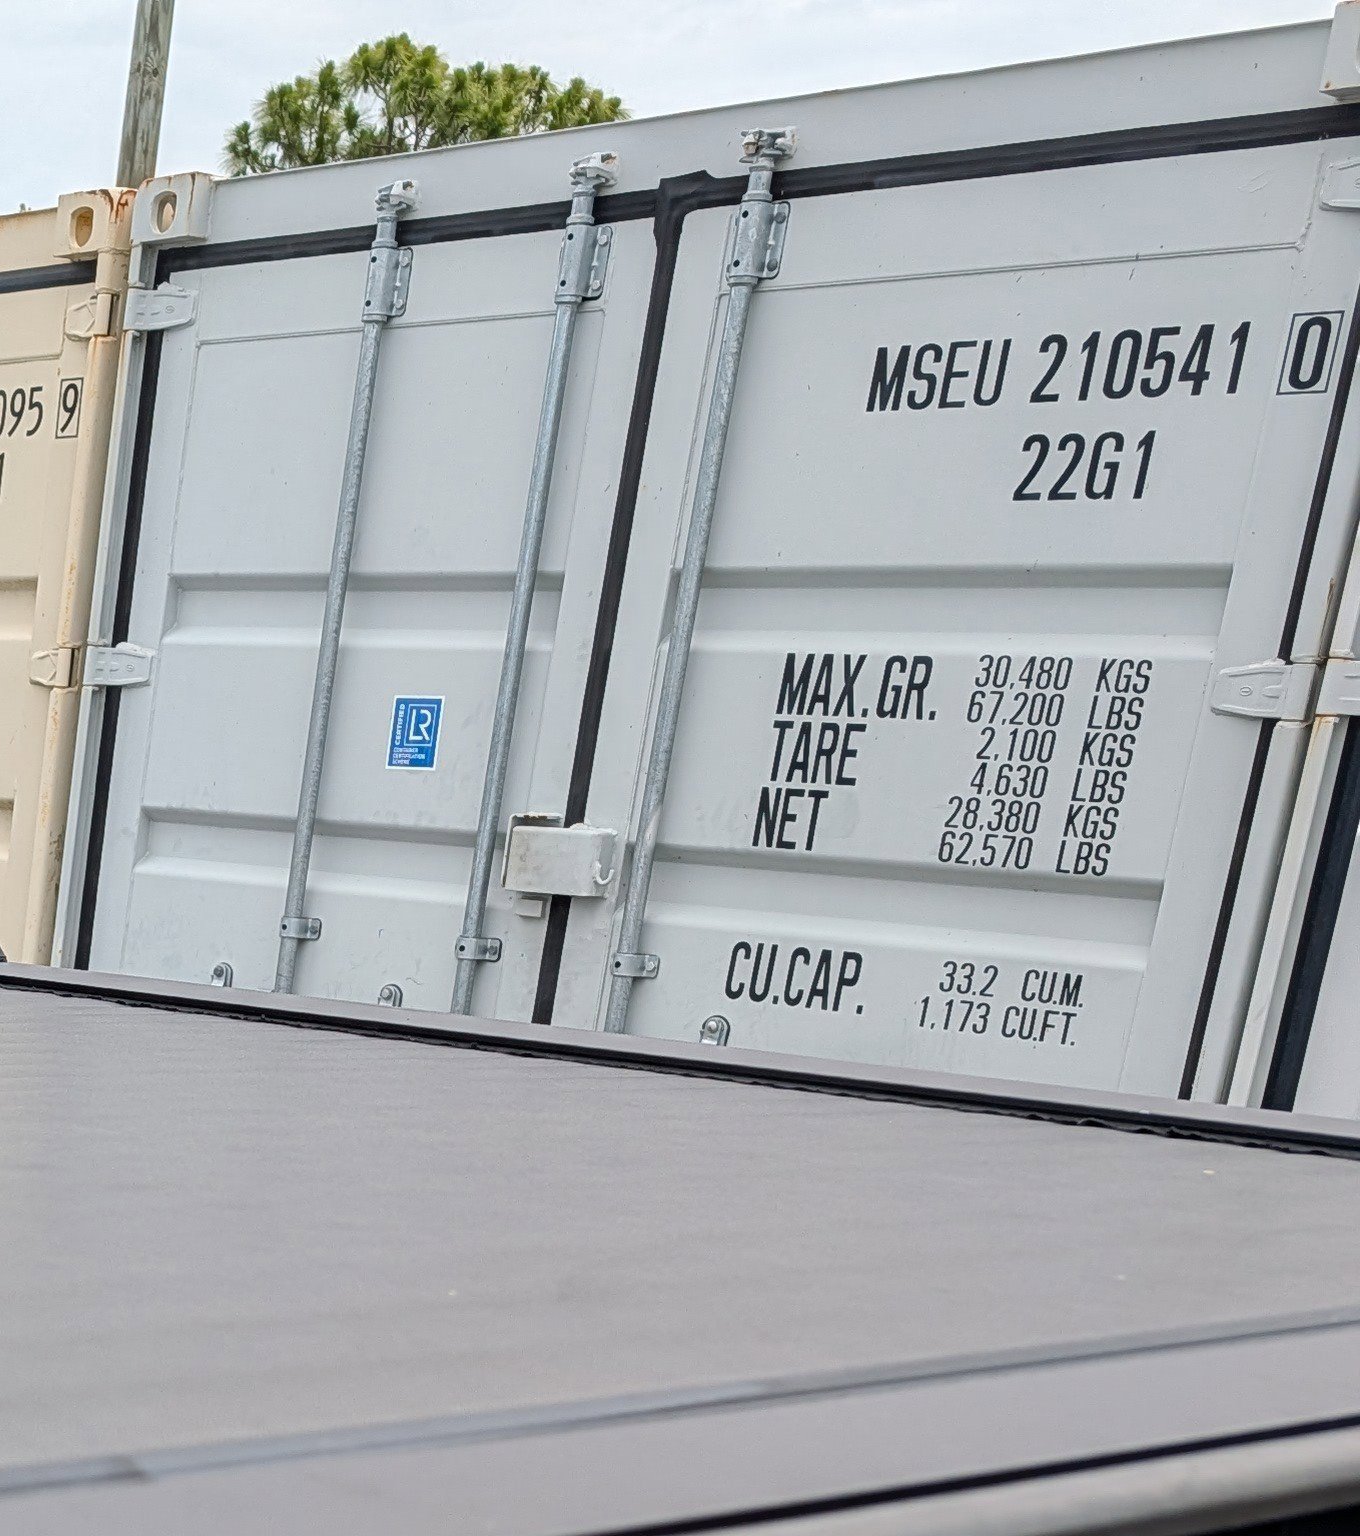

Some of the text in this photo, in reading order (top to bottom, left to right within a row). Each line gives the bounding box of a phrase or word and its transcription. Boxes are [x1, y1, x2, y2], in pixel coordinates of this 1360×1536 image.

[865, 315, 1332, 413] MSEU 210541 0
[59, 382, 80, 434] 9
[1012, 429, 1157, 502] 22G1
[974, 654, 1074, 691] 30,480
[1095, 657, 1153, 695] KGS
[966, 690, 1145, 732] 67,200 LBS
[769, 719, 1137, 787] TARE 2,100 KGS
[970, 761, 1128, 805] 4,630 LBS
[751, 786, 1120, 852] NET 28,380 KGS
[937, 830, 1112, 877] 62,570 LBS
[938, 960, 999, 998] 33.2
